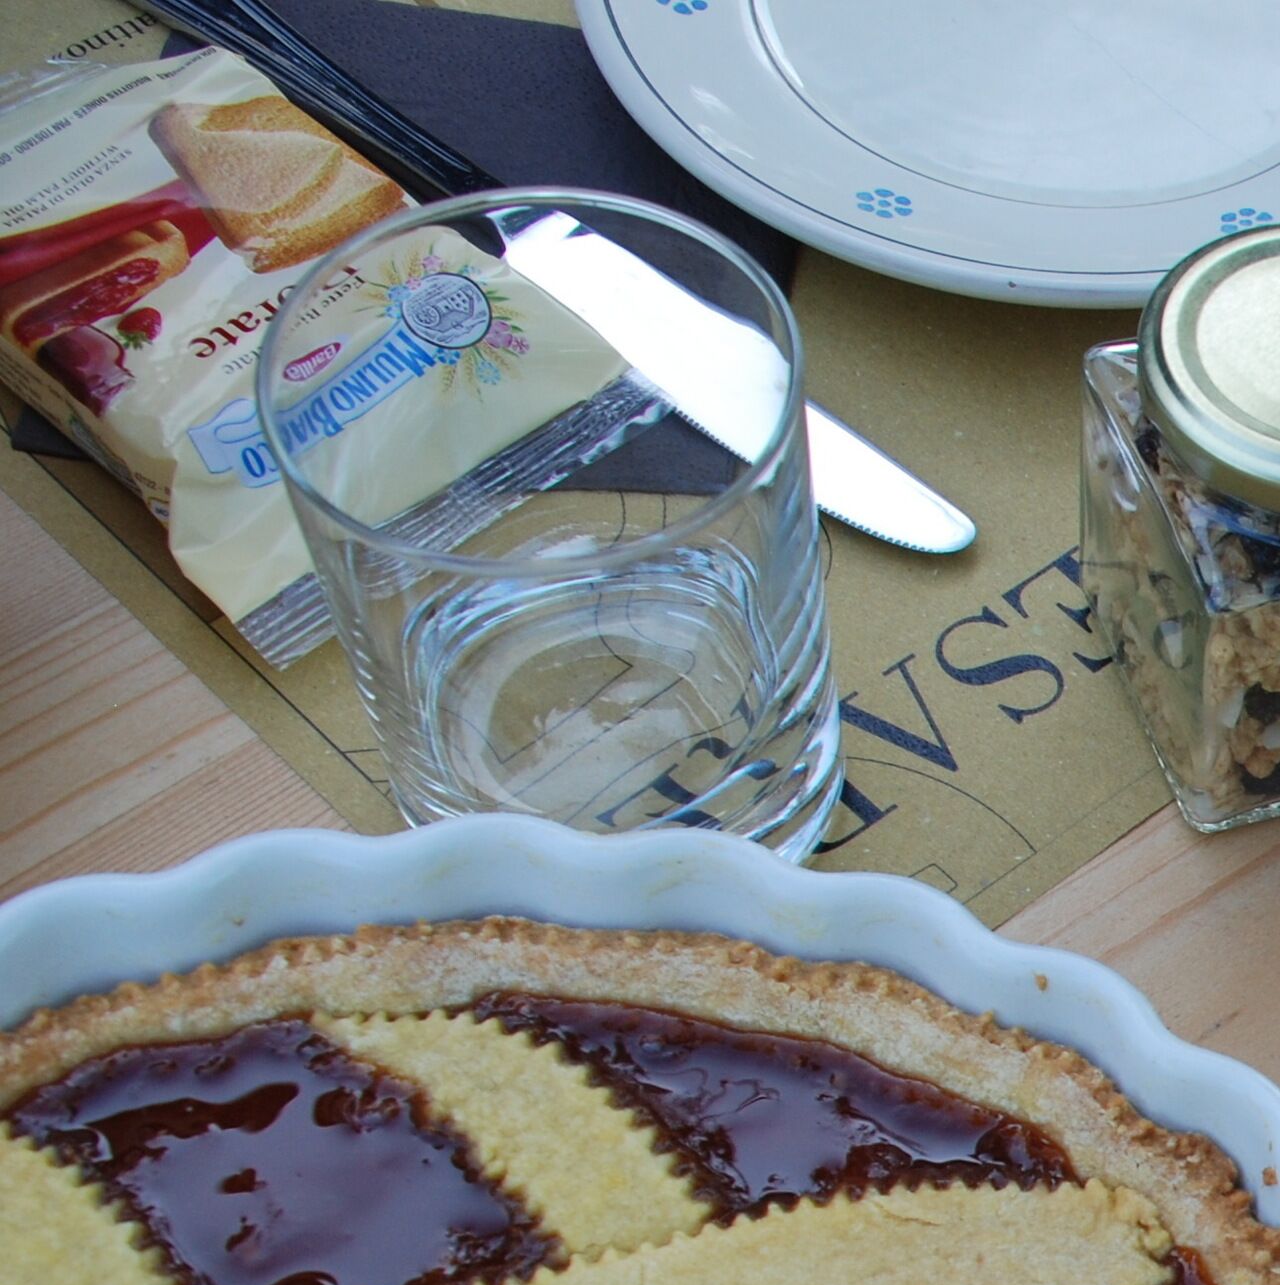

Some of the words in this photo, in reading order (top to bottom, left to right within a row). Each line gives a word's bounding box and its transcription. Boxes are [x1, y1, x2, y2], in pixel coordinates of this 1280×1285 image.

[50, 11, 158, 62] attino»
[61, 144, 120, 185] WITHOUT
[98, 148, 133, 177] SENZA
[50, 190, 65, 208] DI
[65, 174, 96, 199] OLIO
[3, 200, 49, 228] PALMA
[322, 275, 366, 309] Fette
[285, 343, 337, 381] Barilla
[328, 329, 437, 412] MULINO
